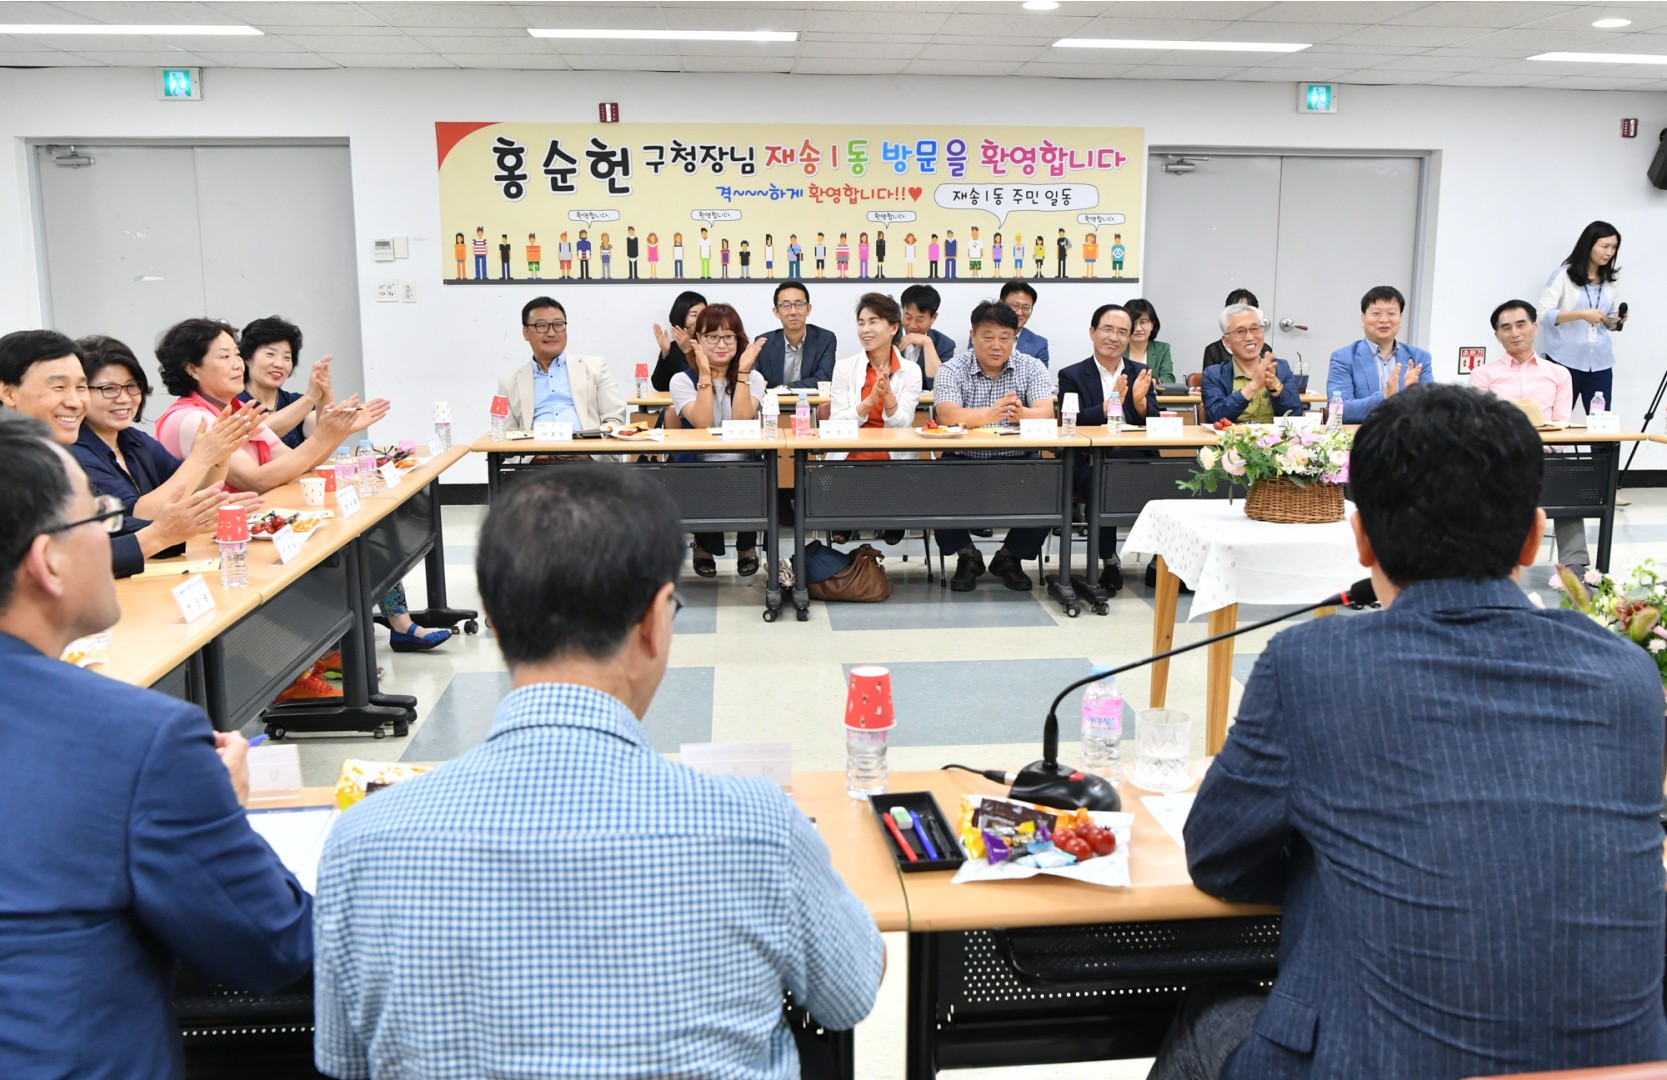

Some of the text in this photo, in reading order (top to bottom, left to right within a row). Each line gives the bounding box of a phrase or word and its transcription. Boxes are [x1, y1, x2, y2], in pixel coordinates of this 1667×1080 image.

[642, 139, 755, 175] 구청장님
[882, 138, 967, 177] 방문을
[980, 138, 1127, 177] 환영합니다
[1012, 188, 1039, 205] 주민
[1044, 187, 1072, 206] 일동
